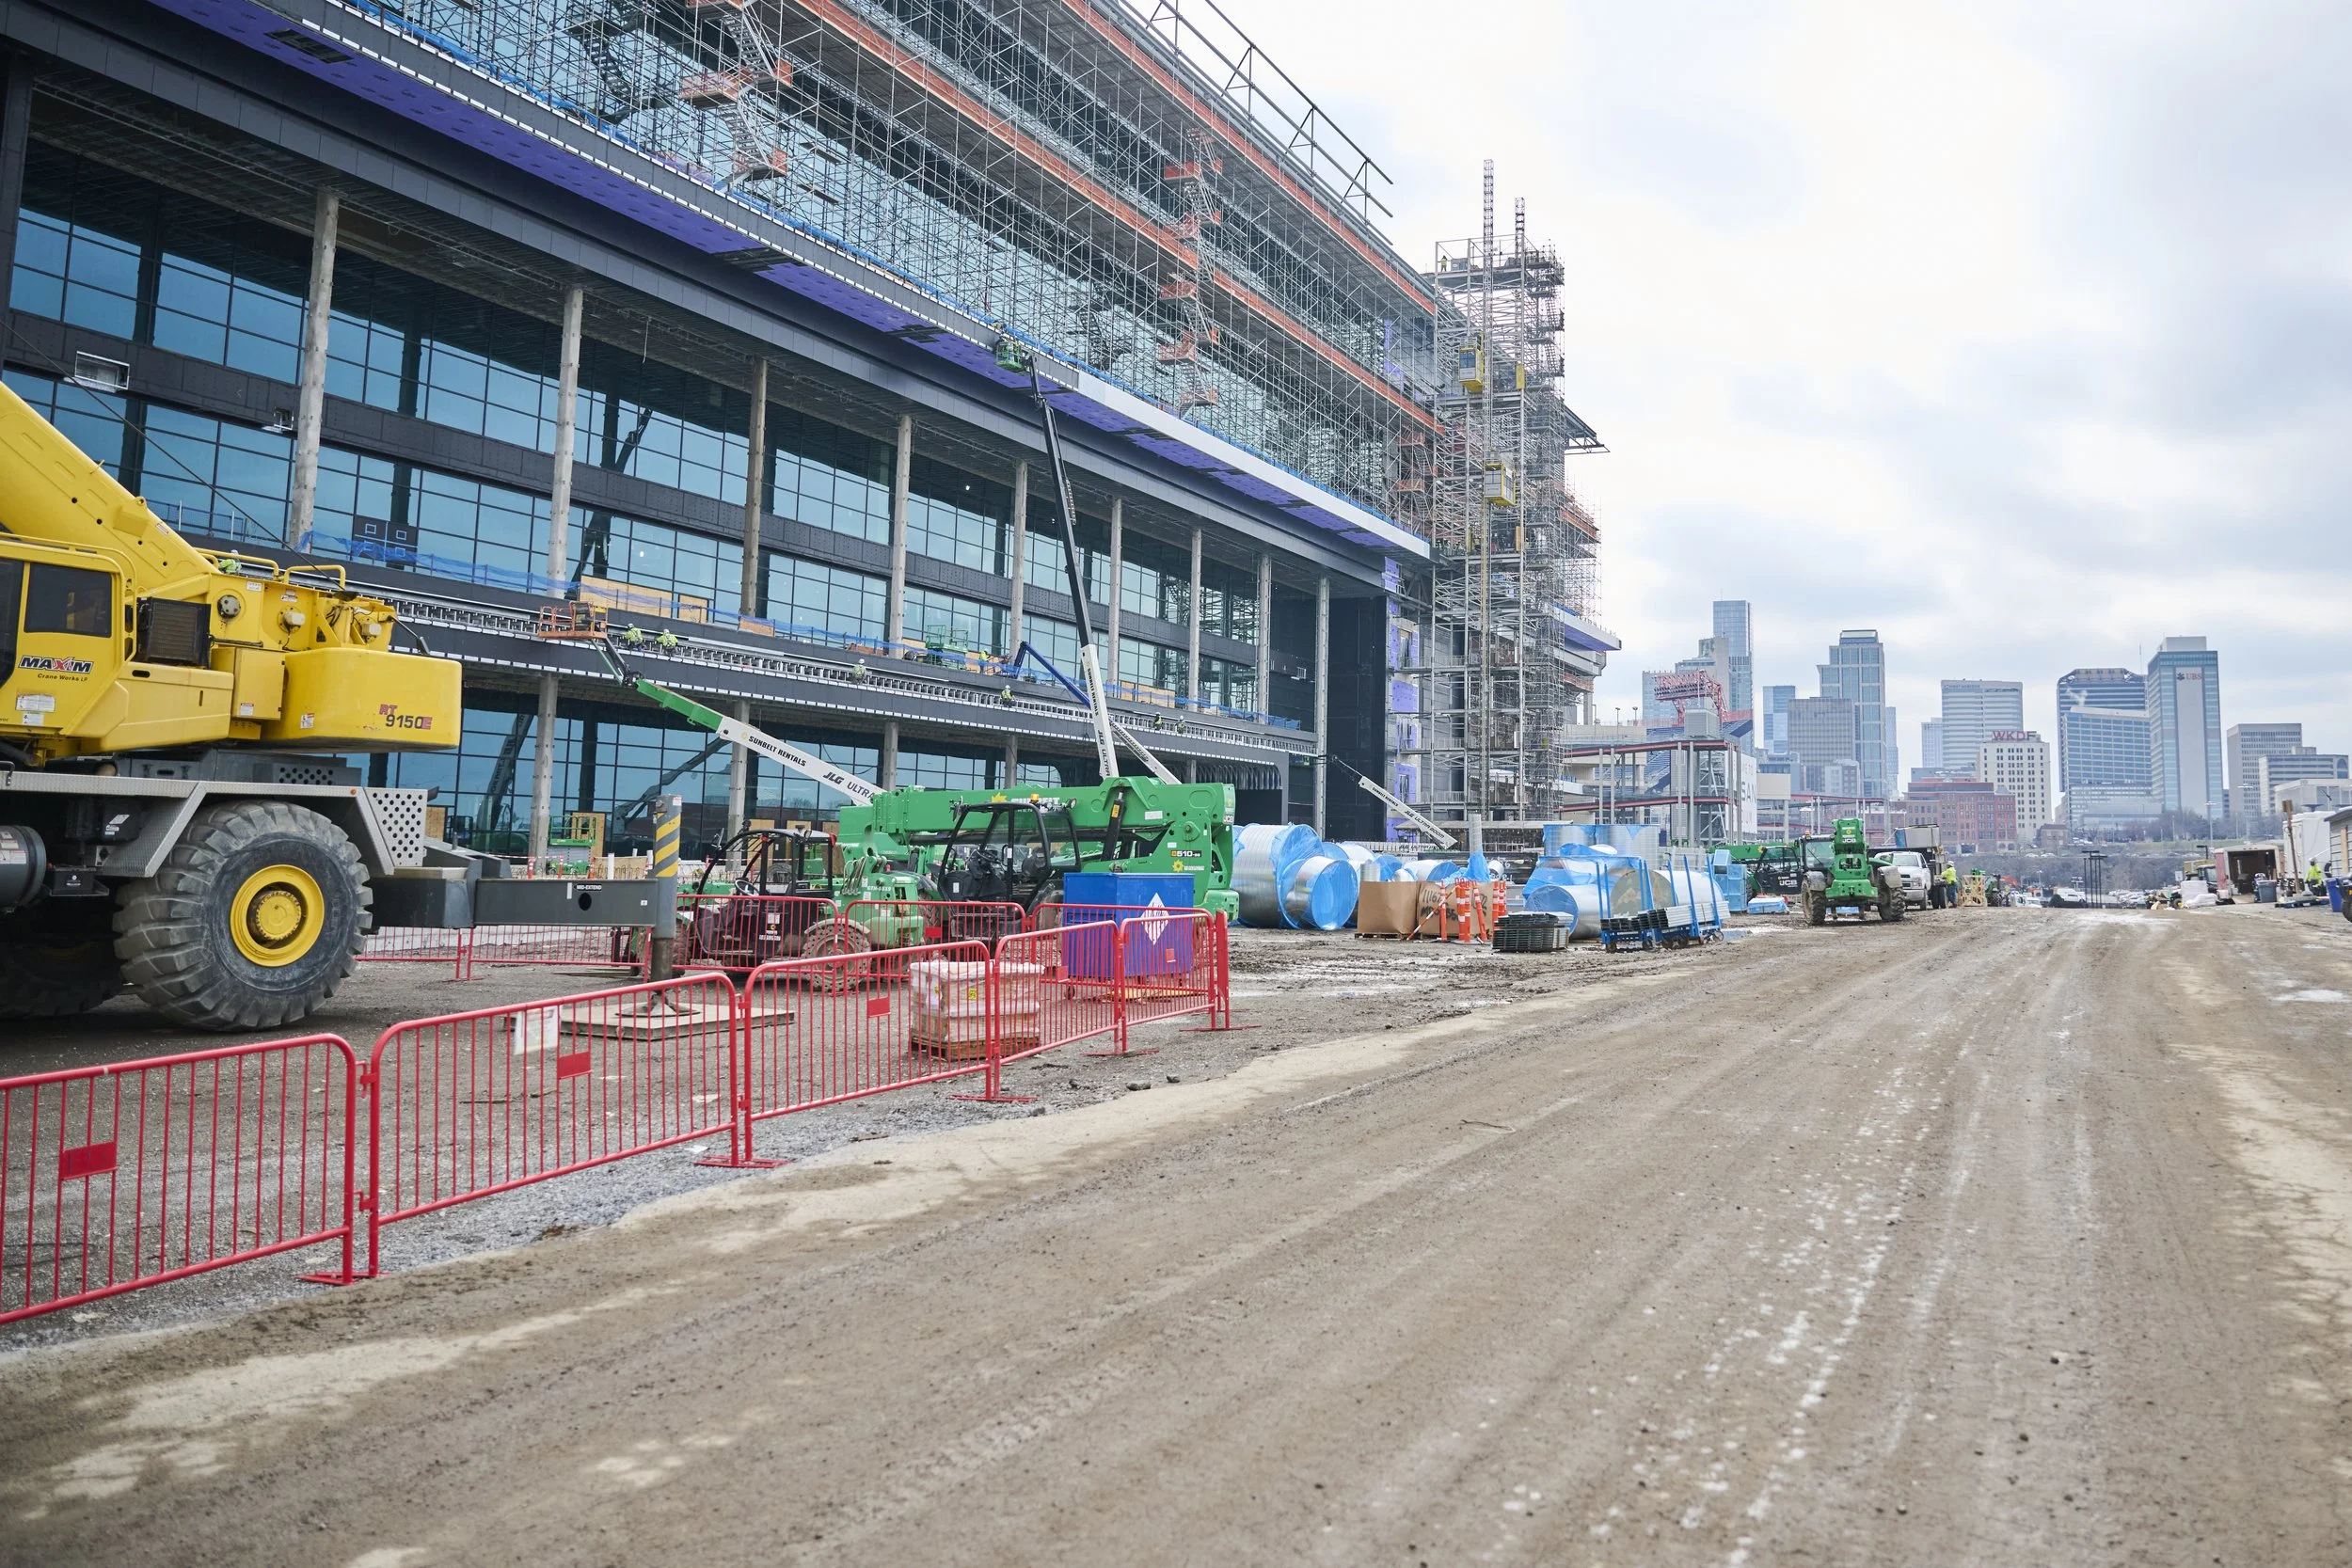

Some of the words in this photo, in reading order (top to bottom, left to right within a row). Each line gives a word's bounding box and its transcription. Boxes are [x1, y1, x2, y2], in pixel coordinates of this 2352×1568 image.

[19, 656, 93, 673] MAXIM
[379, 704, 398, 715] RT
[386, 714, 433, 730] 9150E
[1993, 731, 2037, 741] WKDF
[749, 736, 777, 752] SUNBELT
[778, 749, 806, 767] RENTALS
[822, 771, 845, 785] JLG
